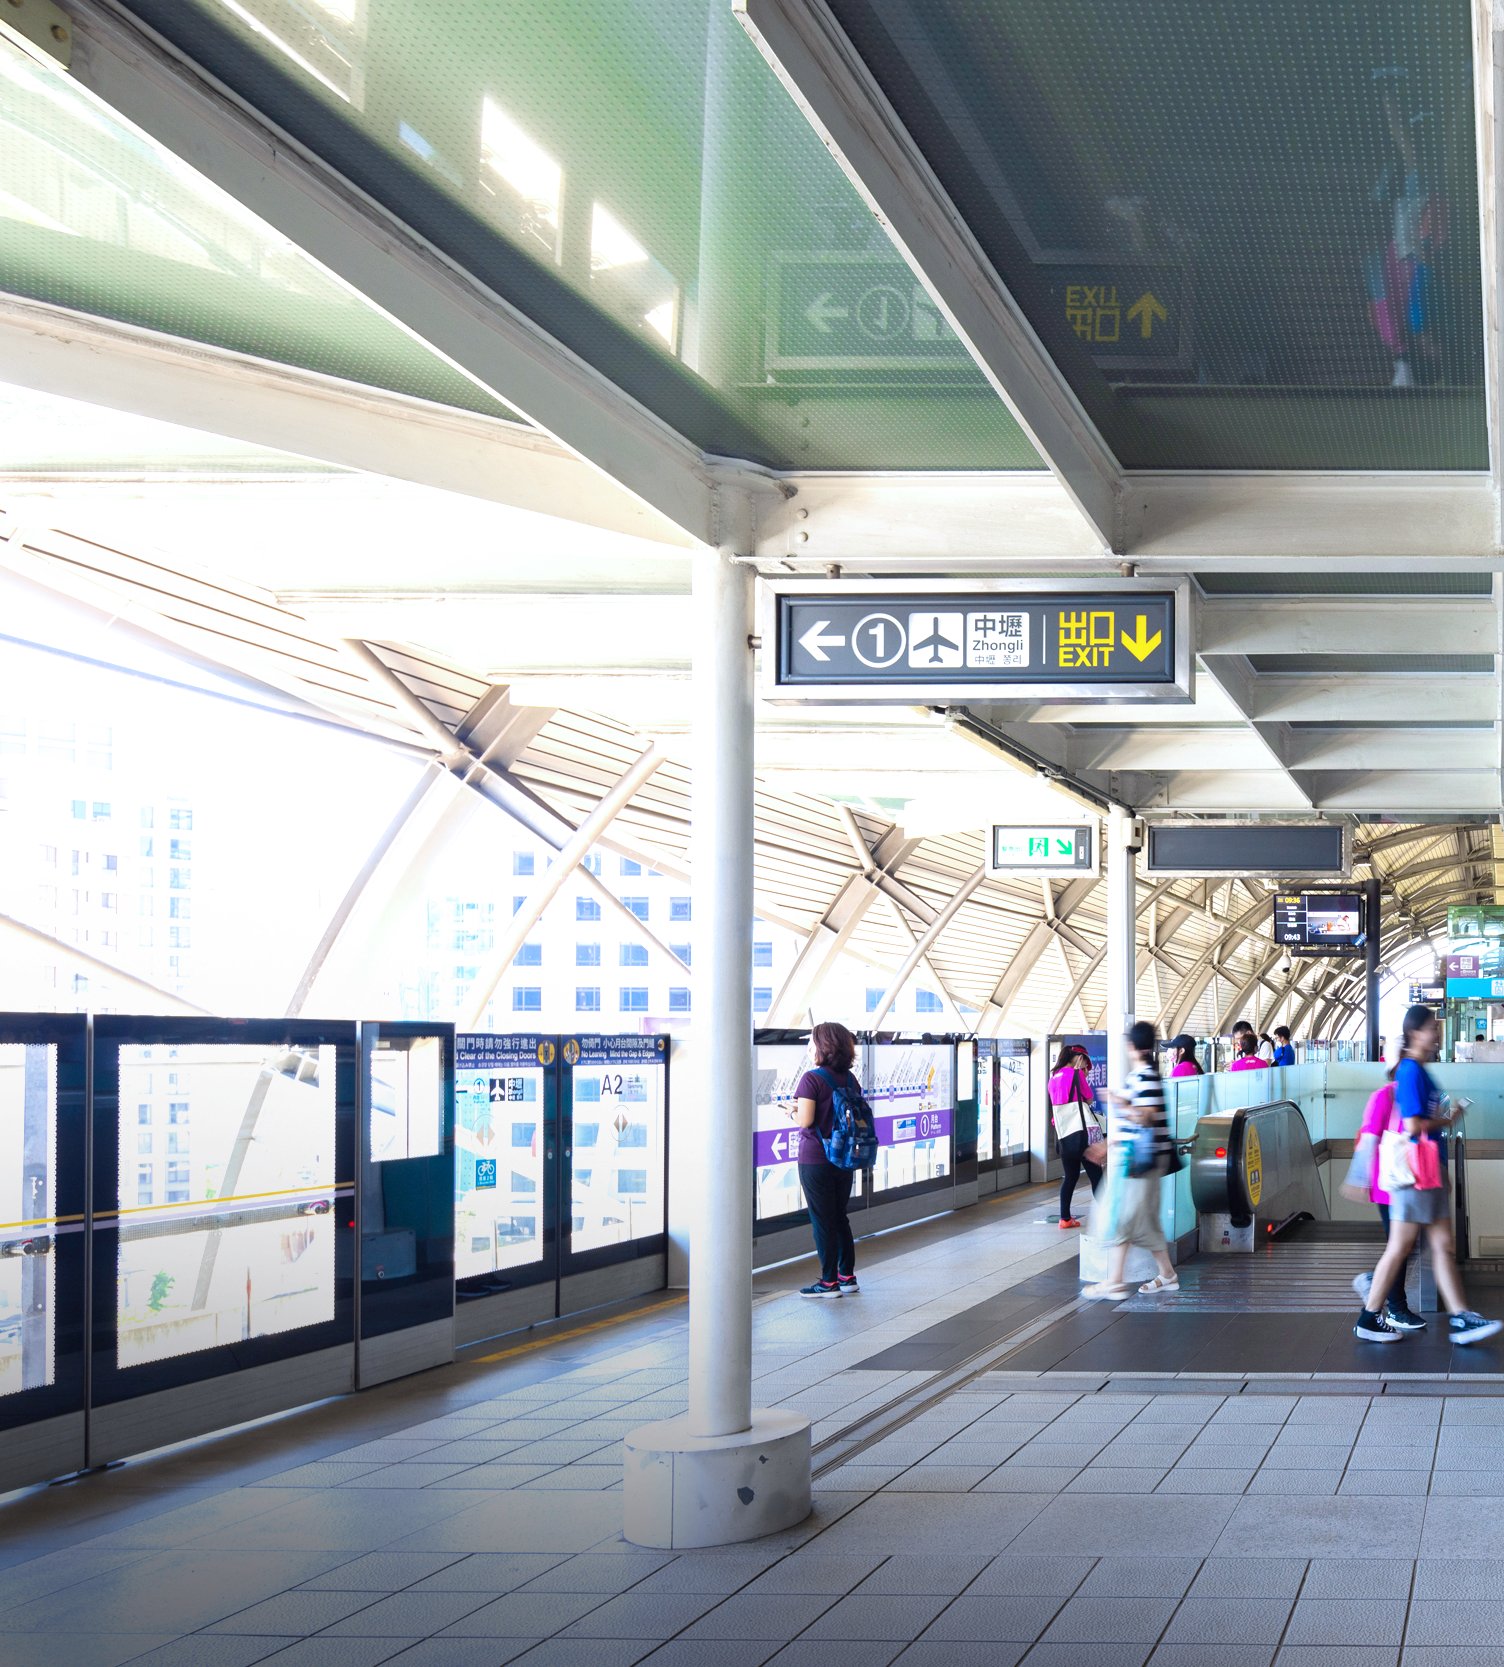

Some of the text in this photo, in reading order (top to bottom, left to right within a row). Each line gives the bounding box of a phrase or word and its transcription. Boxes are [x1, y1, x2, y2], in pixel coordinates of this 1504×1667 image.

[974, 615, 1022, 638] 中壢
[1059, 611, 1115, 646] 出口
[972, 640, 1023, 654] Zhongli
[1059, 647, 1114, 667] EXIT
[460, 1052, 476, 1060] Clear
[496, 1052, 519, 1061] Closing
[589, 1050, 607, 1059] Leaning
[629, 1050, 637, 1058] Gap
[642, 1050, 655, 1059] Edges
[601, 1074, 623, 1095] A2
